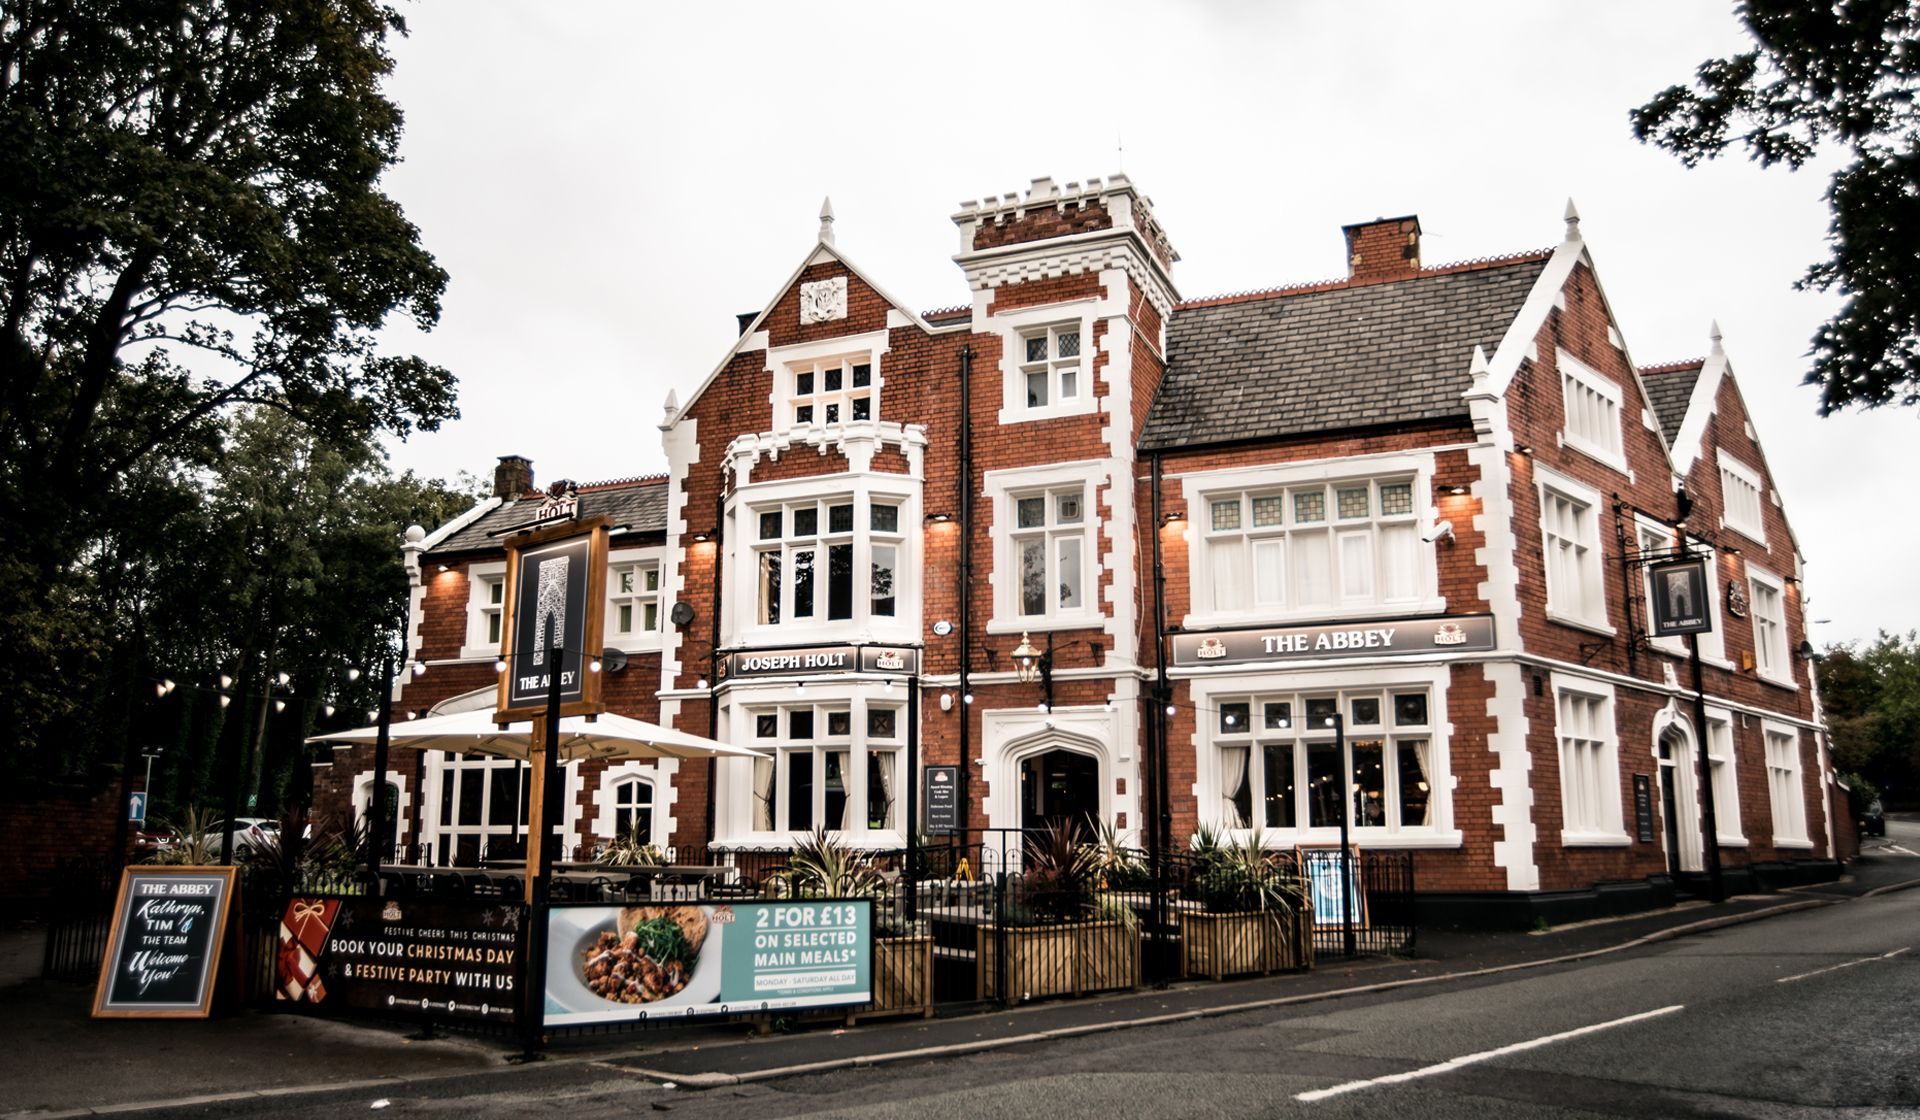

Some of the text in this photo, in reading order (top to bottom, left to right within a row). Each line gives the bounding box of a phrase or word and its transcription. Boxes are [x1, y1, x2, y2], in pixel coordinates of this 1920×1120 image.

[1261, 629, 1396, 654] THE ABBEY
[741, 653, 847, 671] JOSEPH HOLT
[520, 671, 575, 690] THE AEY
[141, 884, 214, 895] THE ABBEY
[137, 899, 205, 926] Kathryn,
[384, 910, 401, 918] HOLT
[712, 913, 735, 922] HOLT
[756, 906, 856, 928] 2 FOR £13
[146, 920, 174, 930] TIM
[142, 935, 188, 944] THE TEAM
[384, 927, 516, 943] FESTIVE CHEERS THIS CHRISTMAS
[755, 931, 856, 948] ON SELECTED
[331, 939, 514, 964] BOOK YOUR CHRISTMAS DAY
[754, 952, 795, 967] MAIN
[129, 949, 189, 972] Welcome
[344, 963, 514, 990] & FESTIVE PARTY WITH US
[756, 978, 787, 986] MONDAY
[793, 976, 828, 985] SATURDAY
